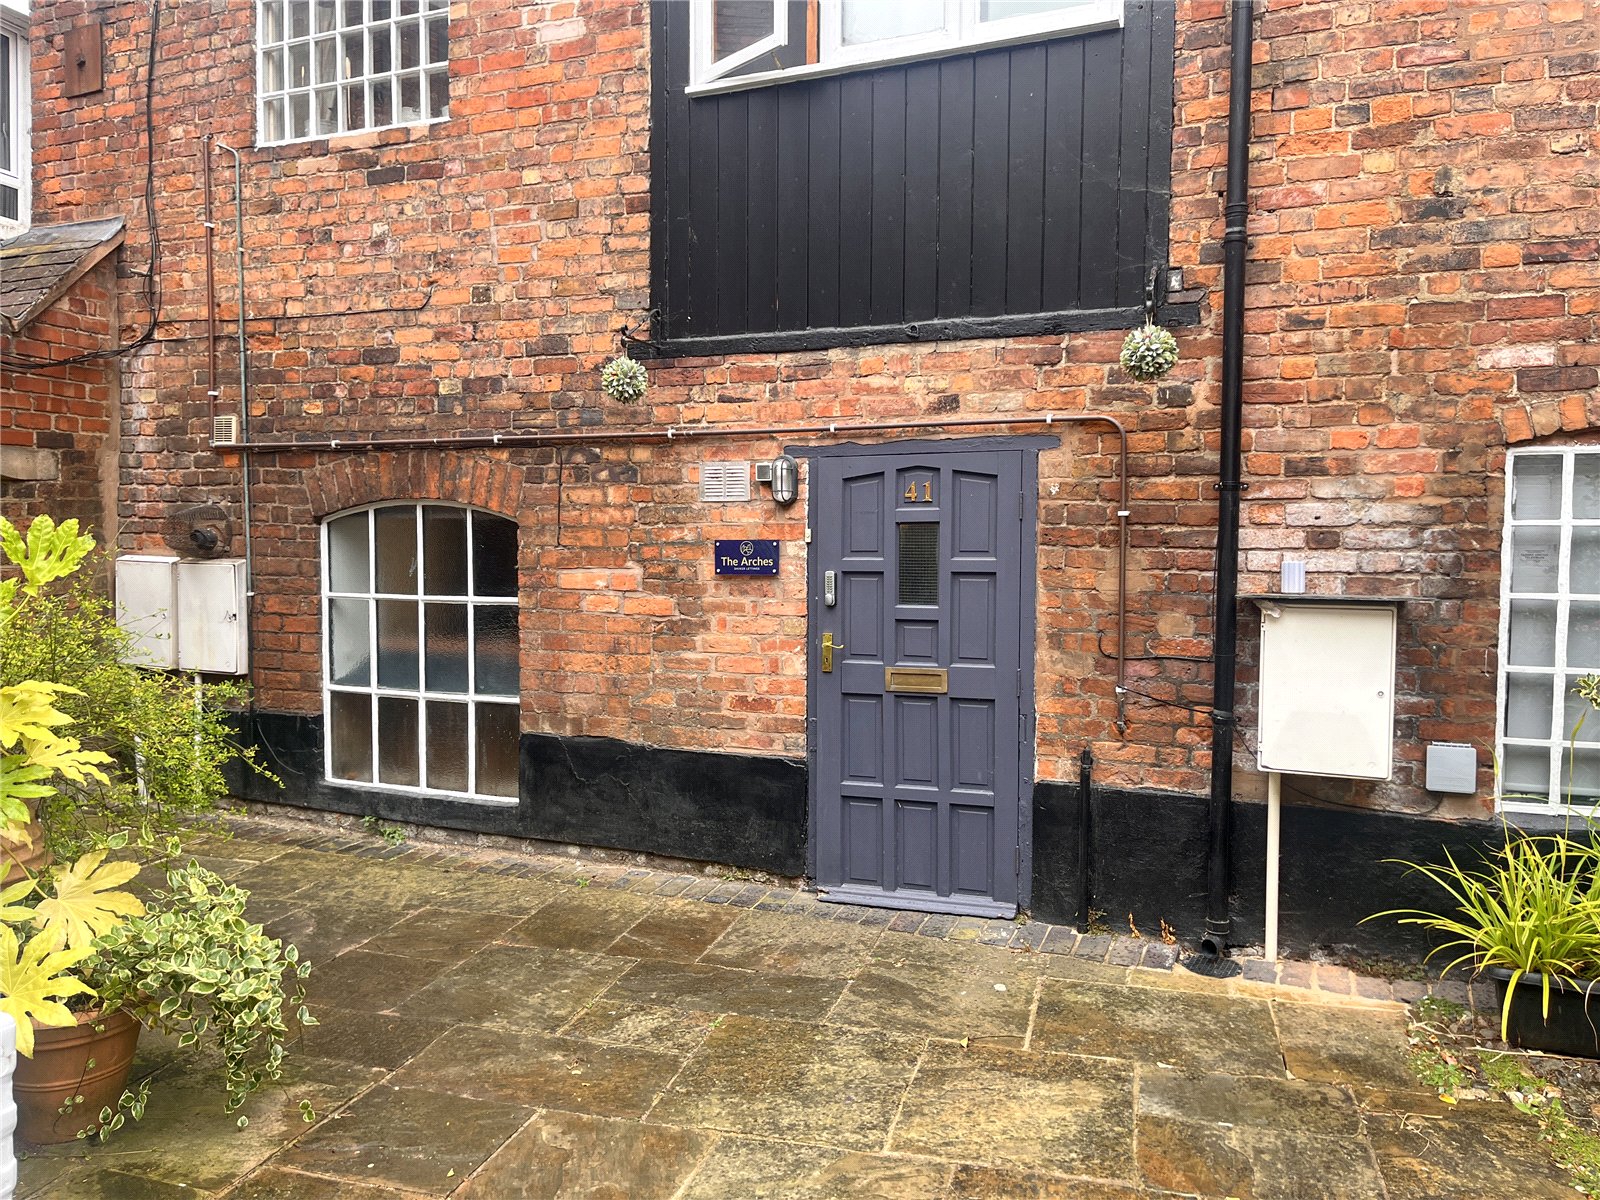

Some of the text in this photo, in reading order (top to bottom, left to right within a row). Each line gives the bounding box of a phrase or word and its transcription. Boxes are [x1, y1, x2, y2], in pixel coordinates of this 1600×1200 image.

[904, 480, 933, 502] 41
[720, 556, 774, 566] The Arches
